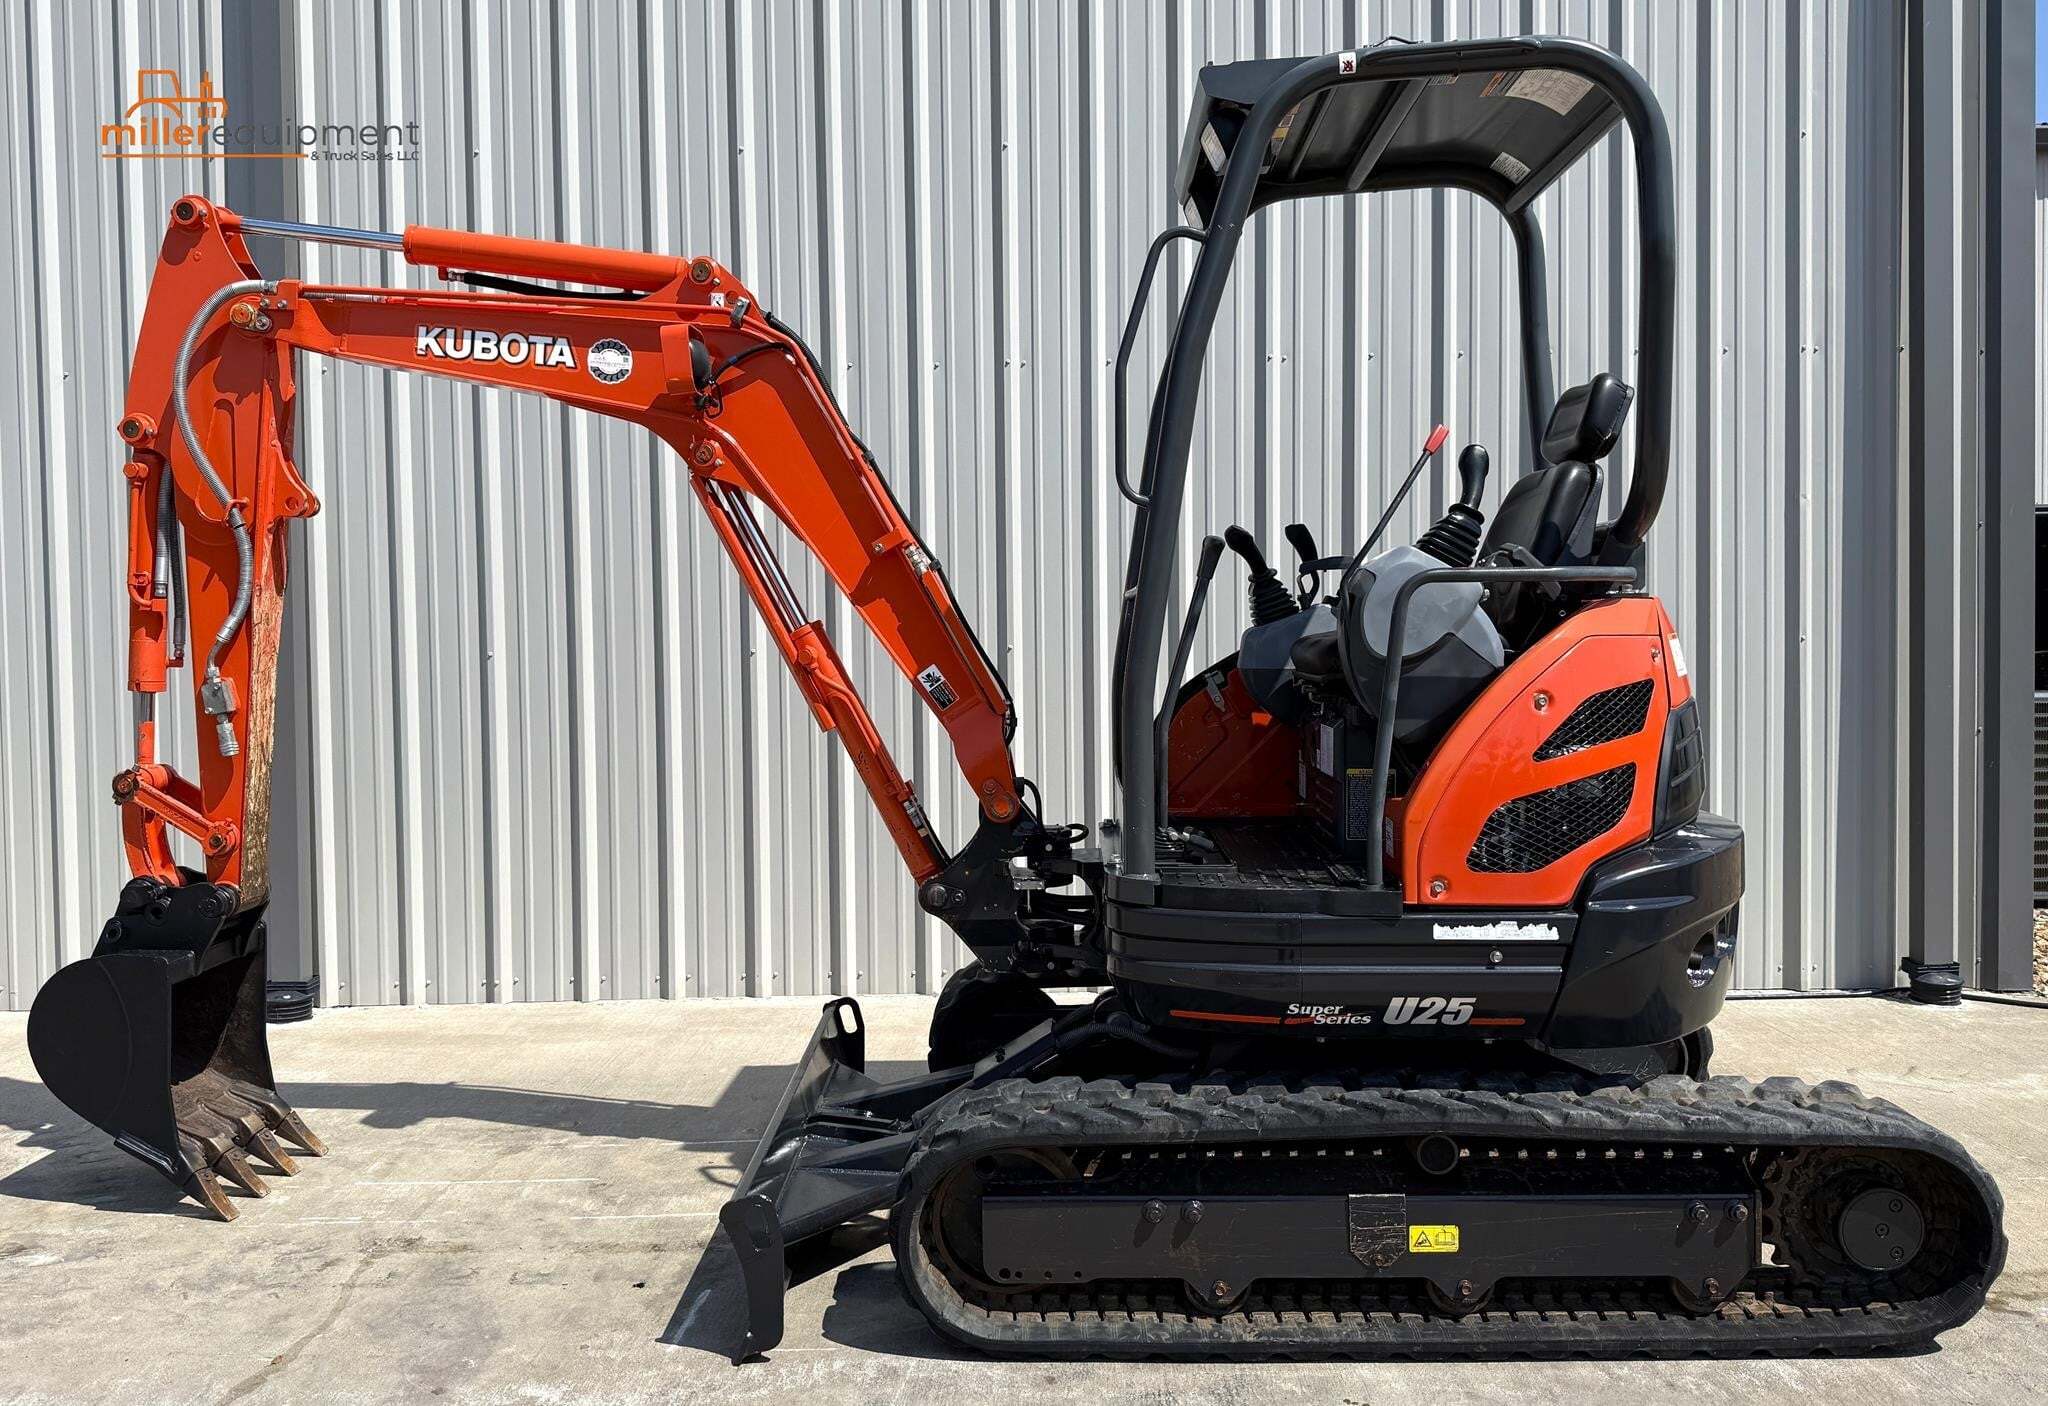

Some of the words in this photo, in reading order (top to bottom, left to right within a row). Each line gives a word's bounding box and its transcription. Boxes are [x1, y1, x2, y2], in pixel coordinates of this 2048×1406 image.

[416, 325, 576, 369] KUBOTA
[1287, 1003, 1344, 1017] Super
[1313, 1013, 1372, 1025] Series
[1382, 996, 1477, 1026] U25
